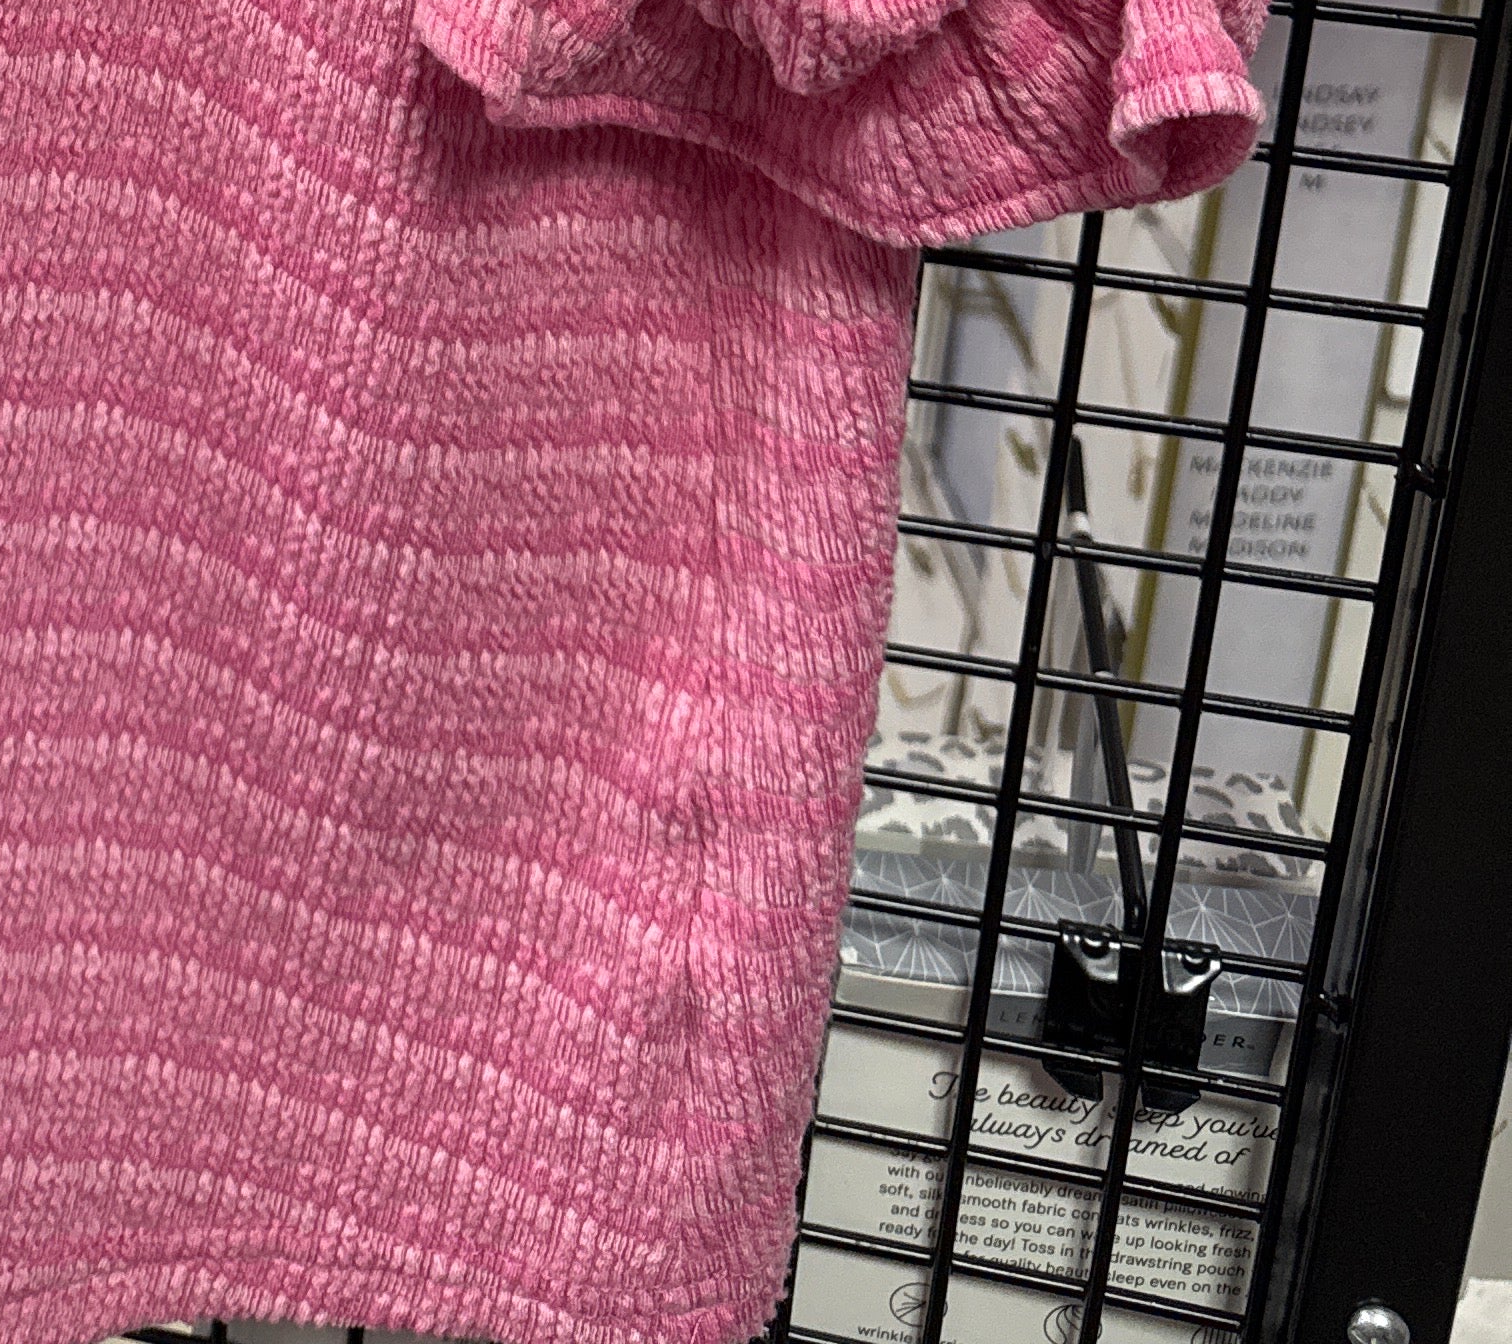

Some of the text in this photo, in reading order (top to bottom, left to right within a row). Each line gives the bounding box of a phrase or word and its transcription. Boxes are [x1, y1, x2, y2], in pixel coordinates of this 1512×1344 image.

[928, 1071, 991, 1103] Te
[1074, 1126, 1213, 1162] dramed
[1214, 1147, 1251, 1167] of
[887, 1164, 921, 1180] with
[924, 1170, 946, 1183] ou
[964, 1173, 1054, 1198] nbelievably
[878, 1182, 914, 1200] soft,
[1021, 1199, 1066, 1219] fabric
[1145, 1216, 1215, 1238] wrinkles,
[1219, 1224, 1256, 1243] frizz,
[890, 1202, 921, 1218] and
[990, 1216, 1010, 1229] so
[1014, 1220, 1042, 1235] you
[1046, 1225, 1076, 1239] can
[1125, 1235, 1146, 1250] up
[1150, 1236, 1207, 1258] looking
[1212, 1243, 1251, 1259] fresh
[878, 1220, 923, 1240] ready
[983, 1234, 1016, 1252] day!
[1021, 1238, 1056, 1256] Toss
[1059, 1243, 1075, 1258] in
[1110, 1252, 1193, 1276] drawstring
[1196, 1263, 1246, 1277] pouch
[1149, 1278, 1187, 1291] even
[1191, 1281, 1212, 1293] on
[1216, 1282, 1242, 1296] the
